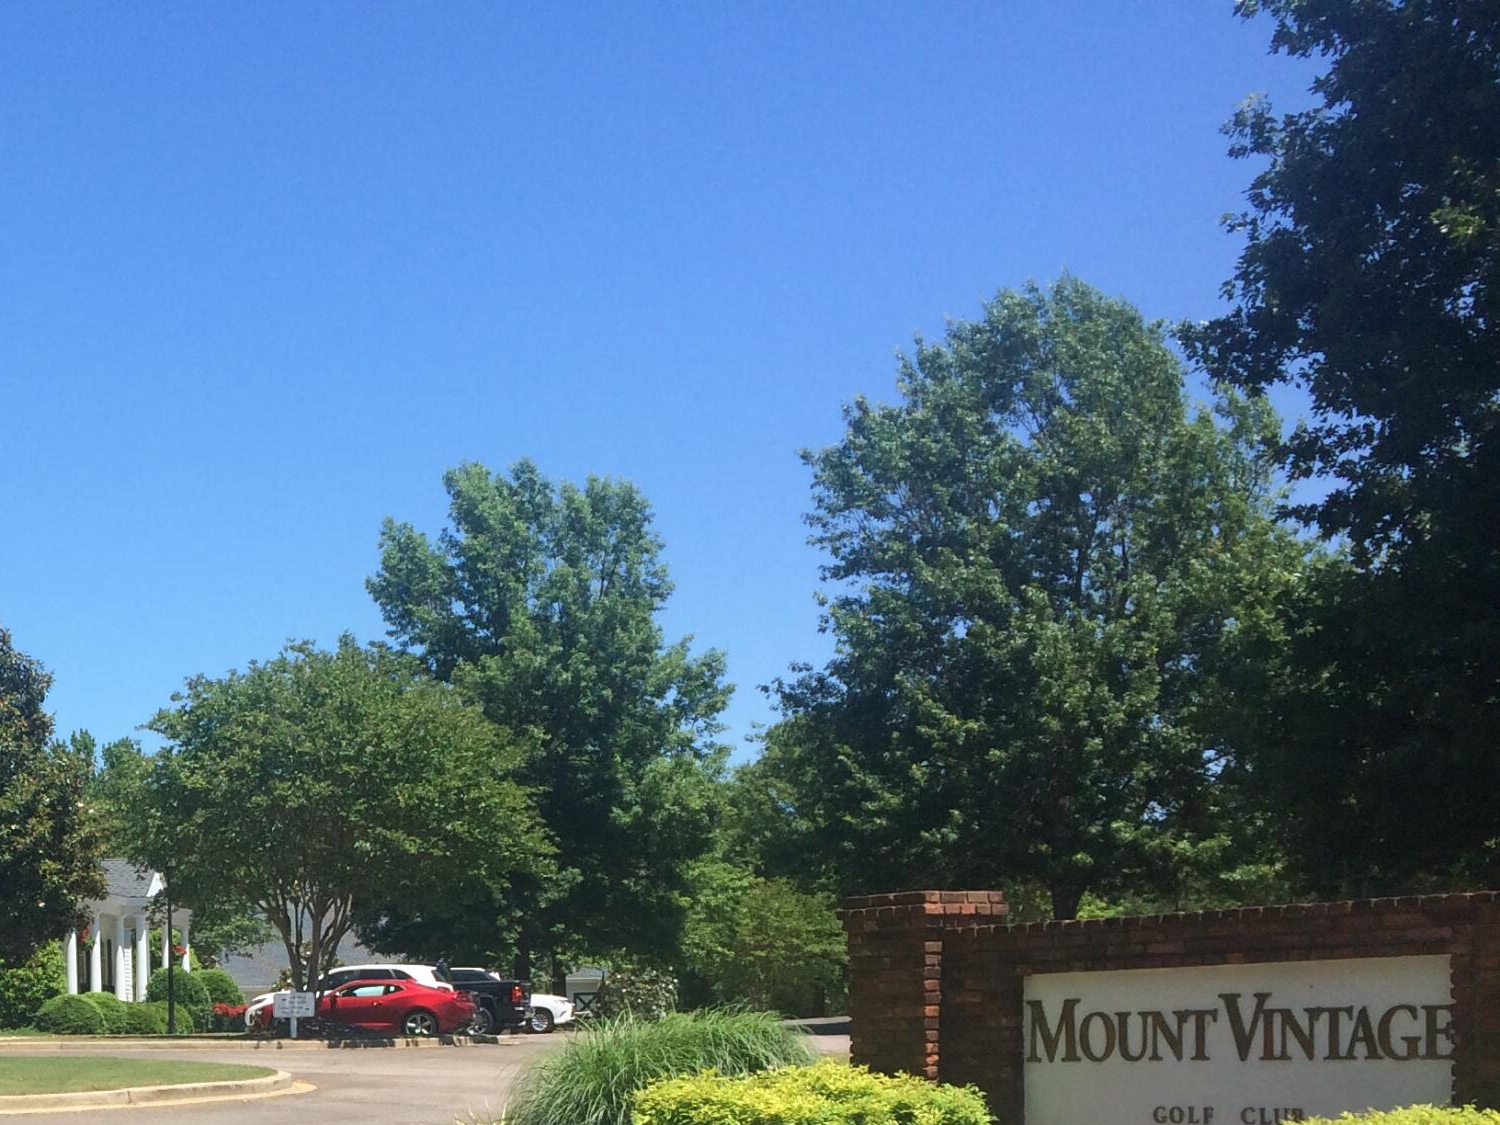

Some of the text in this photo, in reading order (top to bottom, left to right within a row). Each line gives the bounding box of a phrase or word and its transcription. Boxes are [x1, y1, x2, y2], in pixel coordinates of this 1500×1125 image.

[1026, 993, 1453, 1062] MOUNT VINTAGE
[1152, 1106, 1215, 1125] GOLF
